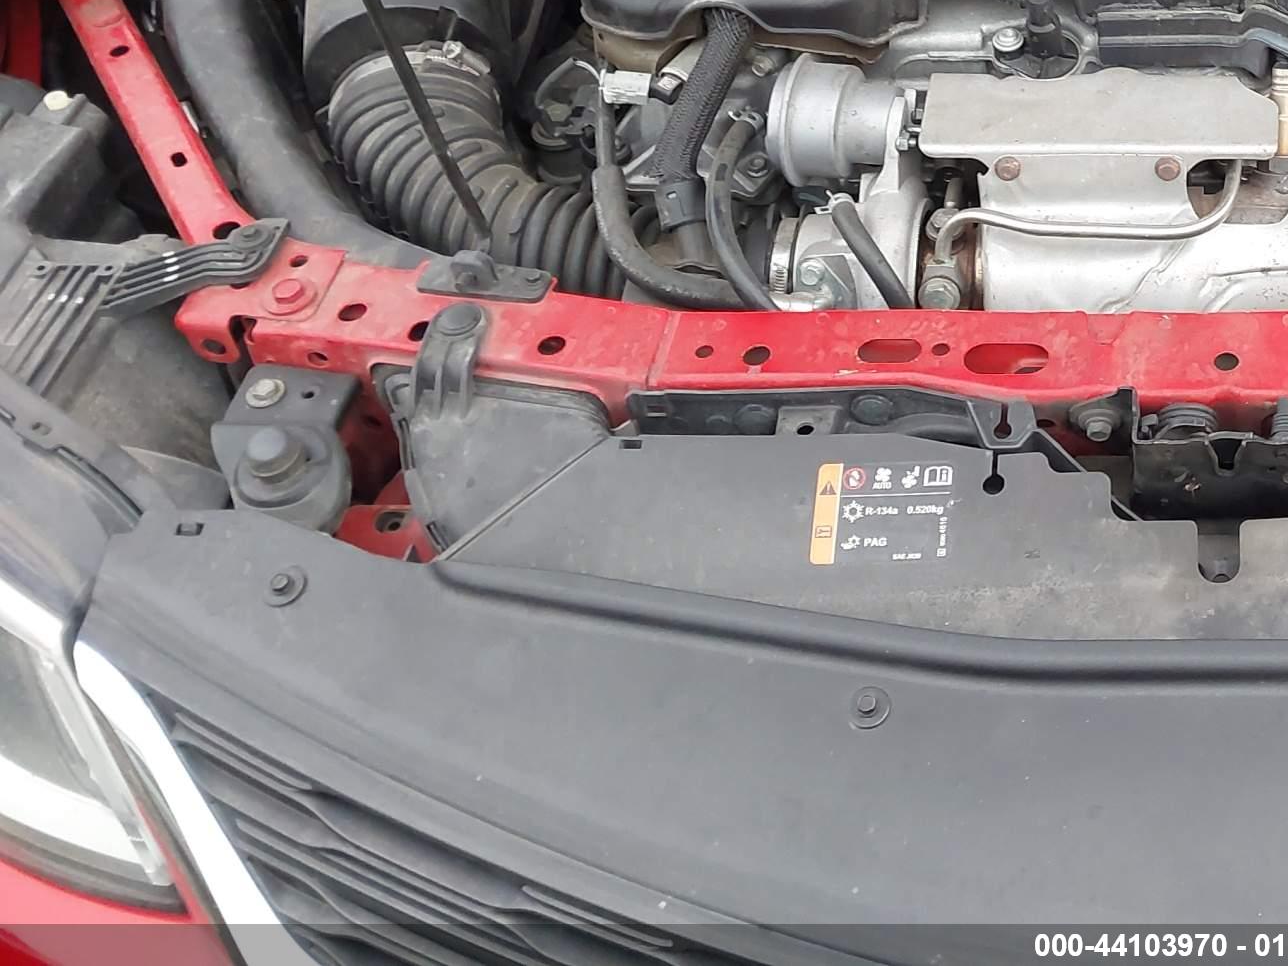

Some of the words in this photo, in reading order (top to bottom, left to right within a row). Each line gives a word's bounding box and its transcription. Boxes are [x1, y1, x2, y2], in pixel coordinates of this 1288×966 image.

[872, 481, 892, 489] AUTO
[865, 506, 898, 515] R-134a
[906, 505, 944, 515] 0.520kg
[863, 537, 887, 547] PAG
